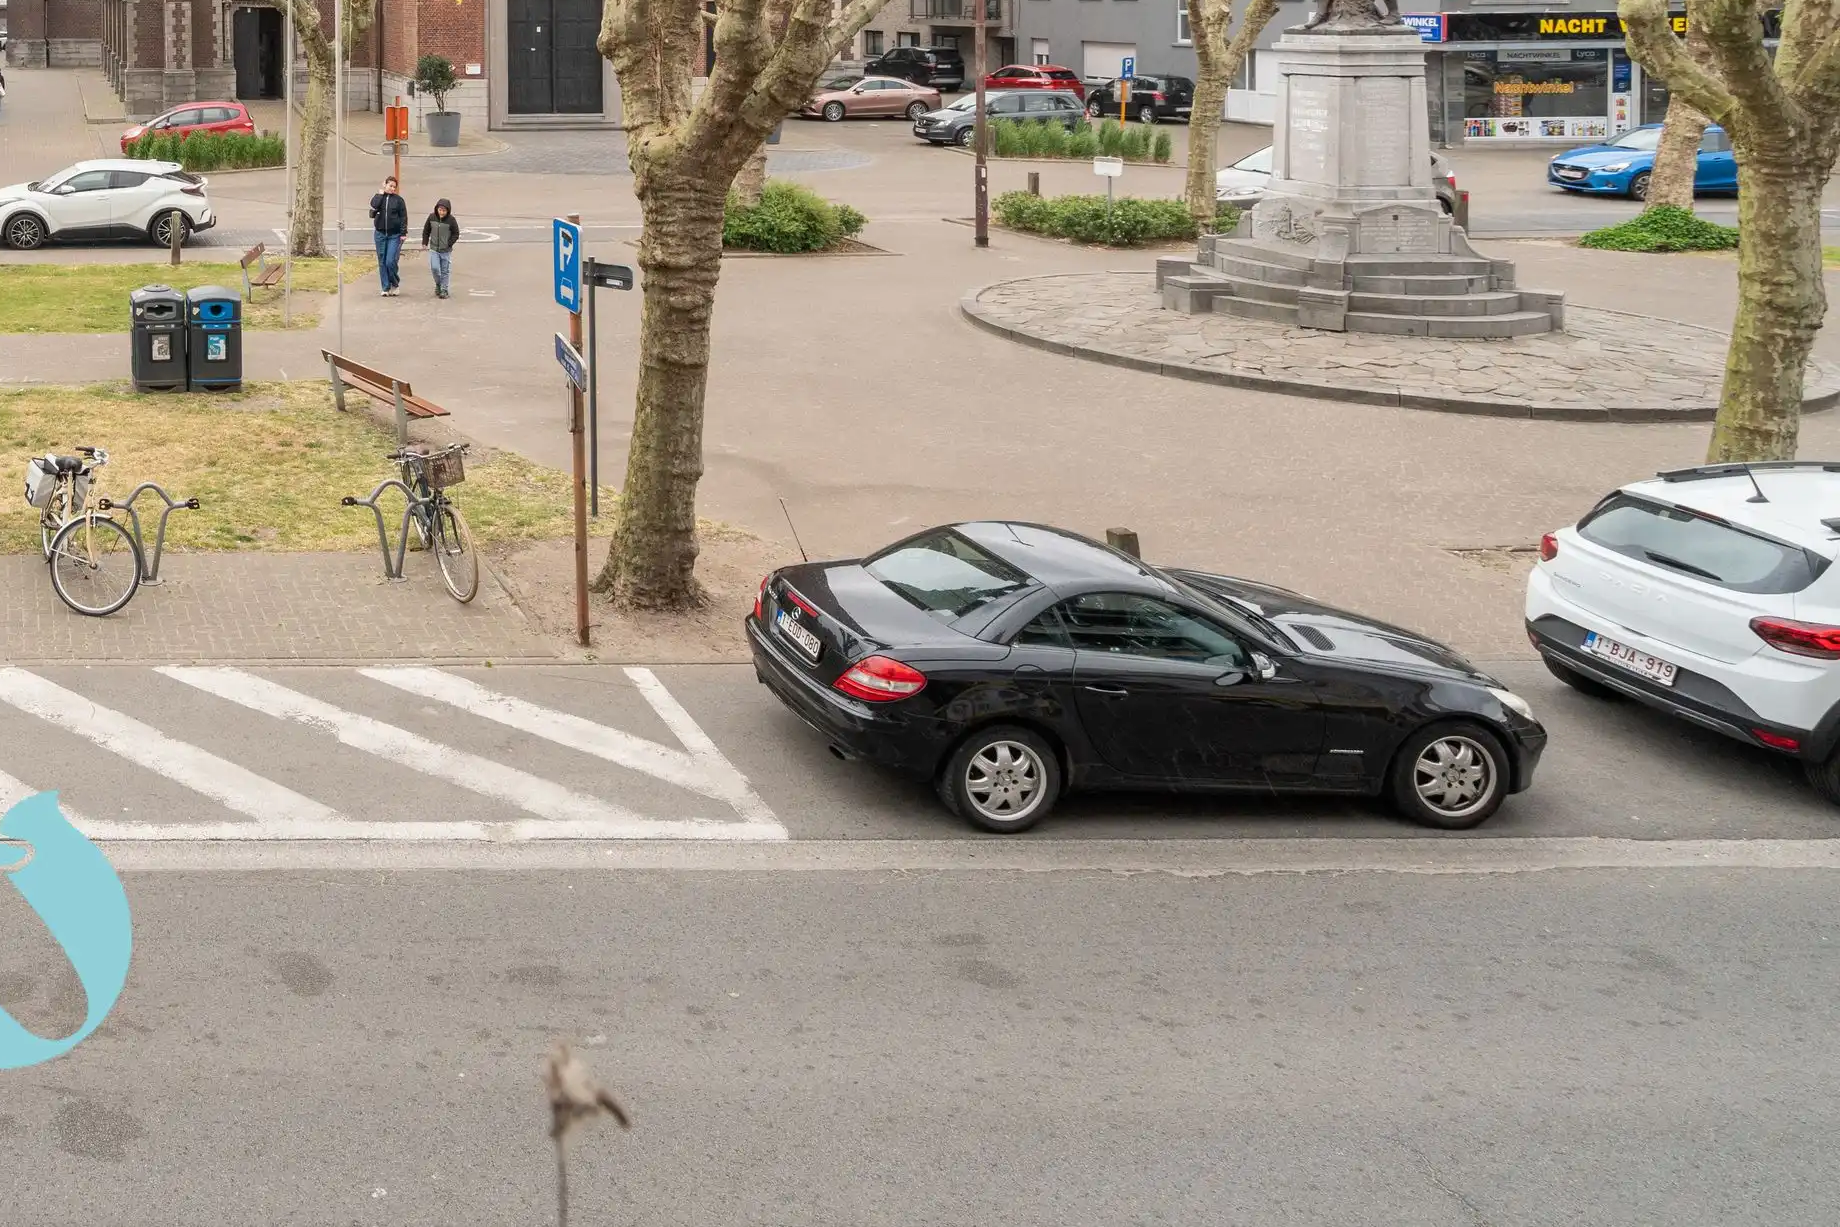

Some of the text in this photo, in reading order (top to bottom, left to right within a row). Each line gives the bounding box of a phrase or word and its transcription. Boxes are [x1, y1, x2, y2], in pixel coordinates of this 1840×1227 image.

[1540, 18, 1607, 34] NACHT
[1125, 59, 1132, 71] P
[1493, 80, 1574, 94] Nachtwinkel
[1596, 637, 1674, 678] 1-BJA-919
